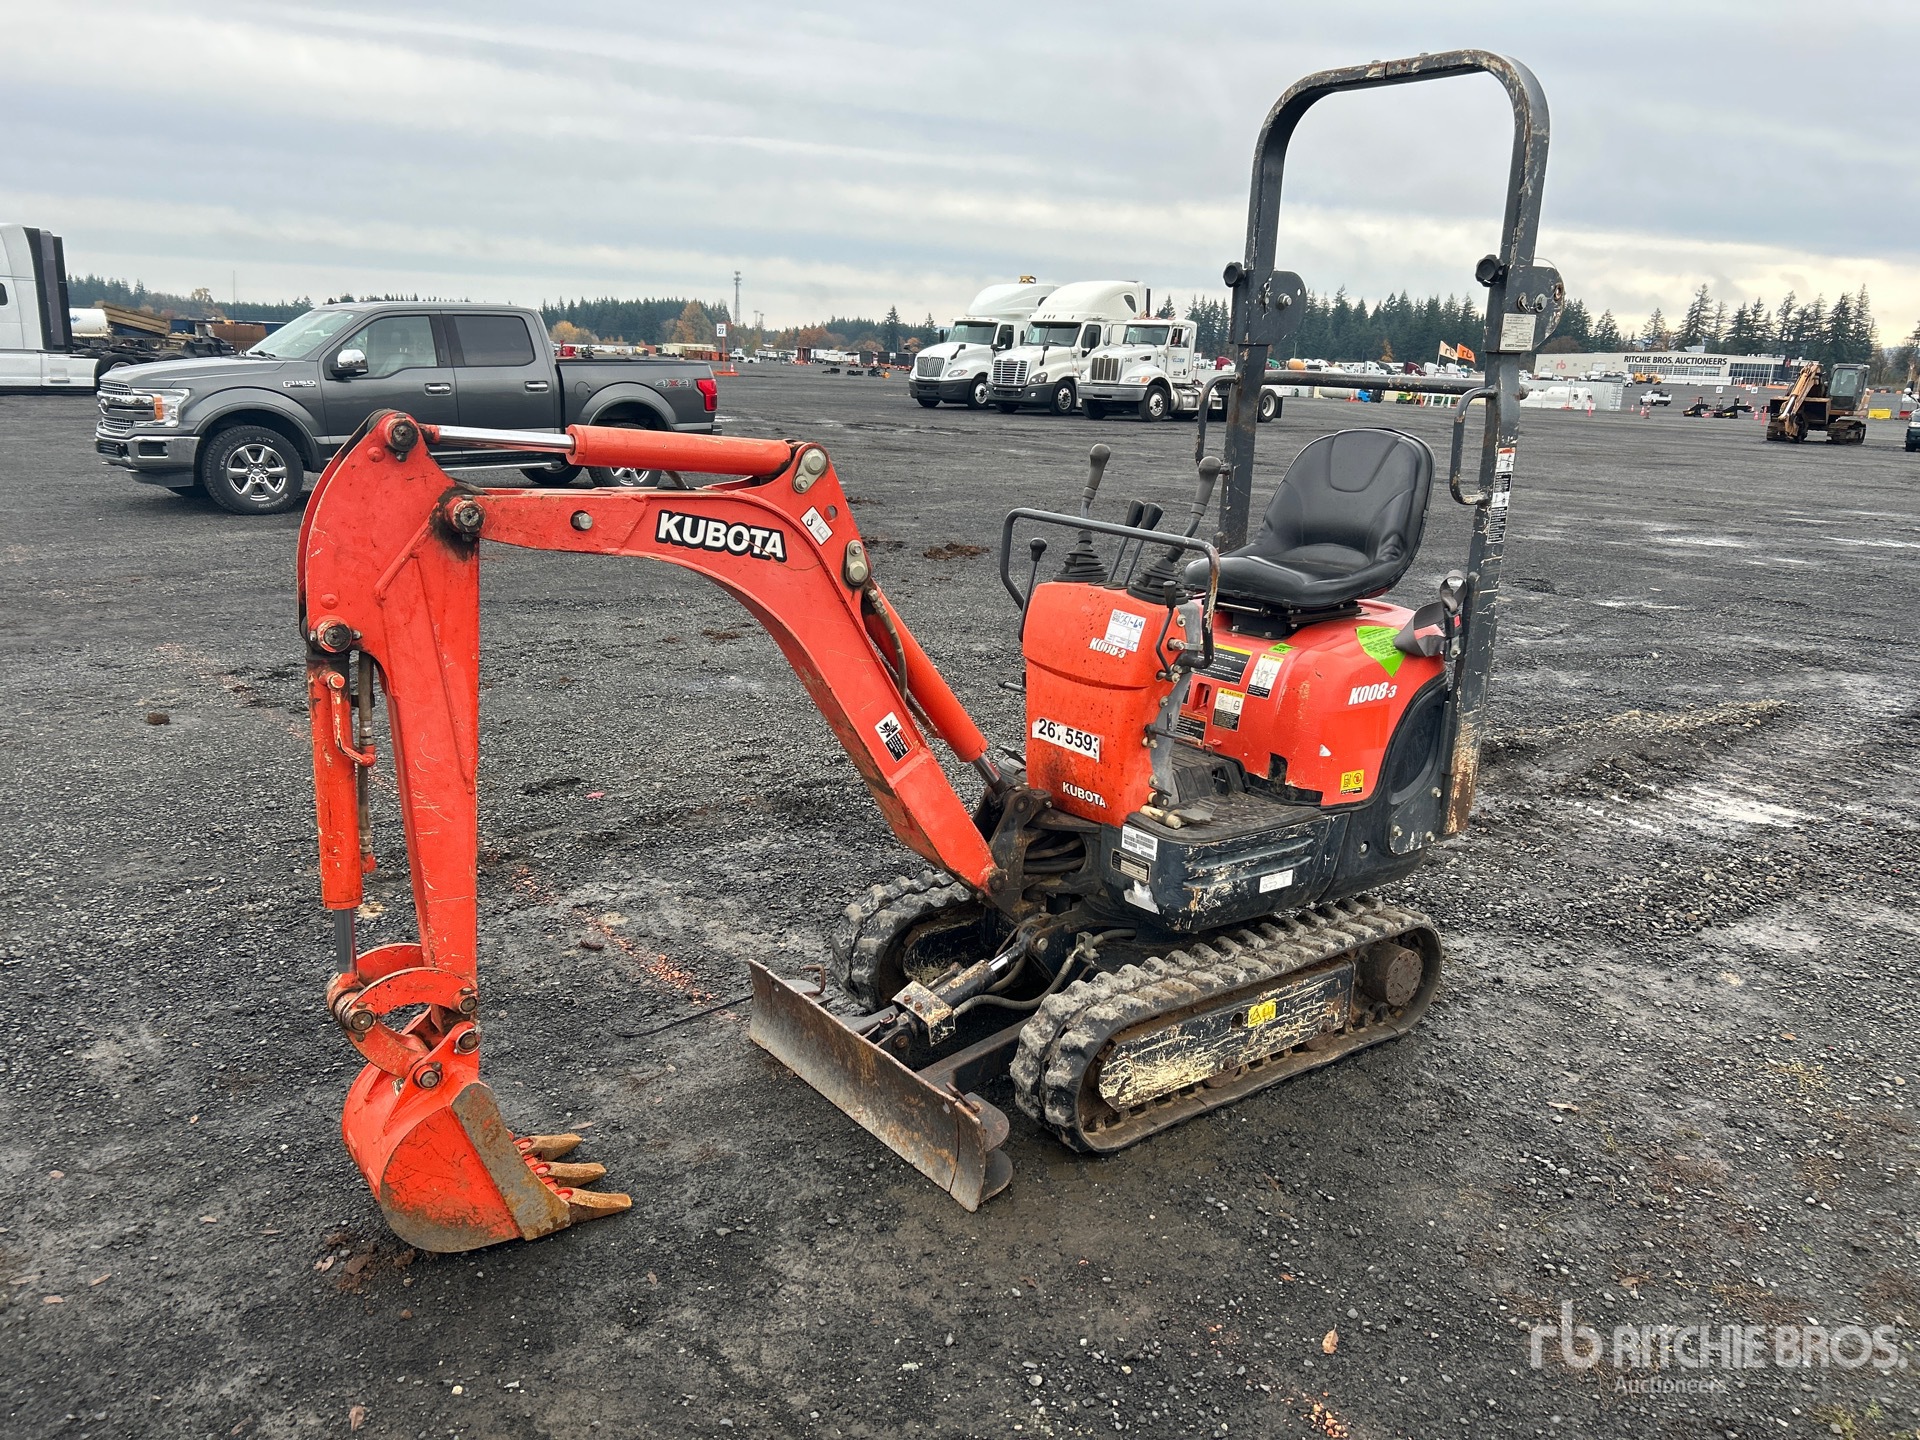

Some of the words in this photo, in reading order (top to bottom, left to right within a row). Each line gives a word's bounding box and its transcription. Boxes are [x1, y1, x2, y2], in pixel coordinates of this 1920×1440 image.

[718, 327, 724, 335] 27
[1461, 349, 1472, 358] rb
[1555, 360, 1567, 369] rb
[1623, 355, 1651, 363] RITCHIE
[1652, 356, 1674, 364] BROS.
[1674, 357, 1728, 365] AUCTIONEERS
[656, 511, 785, 560] KUBOTA
[1347, 681, 1398, 706] K008-3
[1062, 781, 1107, 808] KUBOTA
